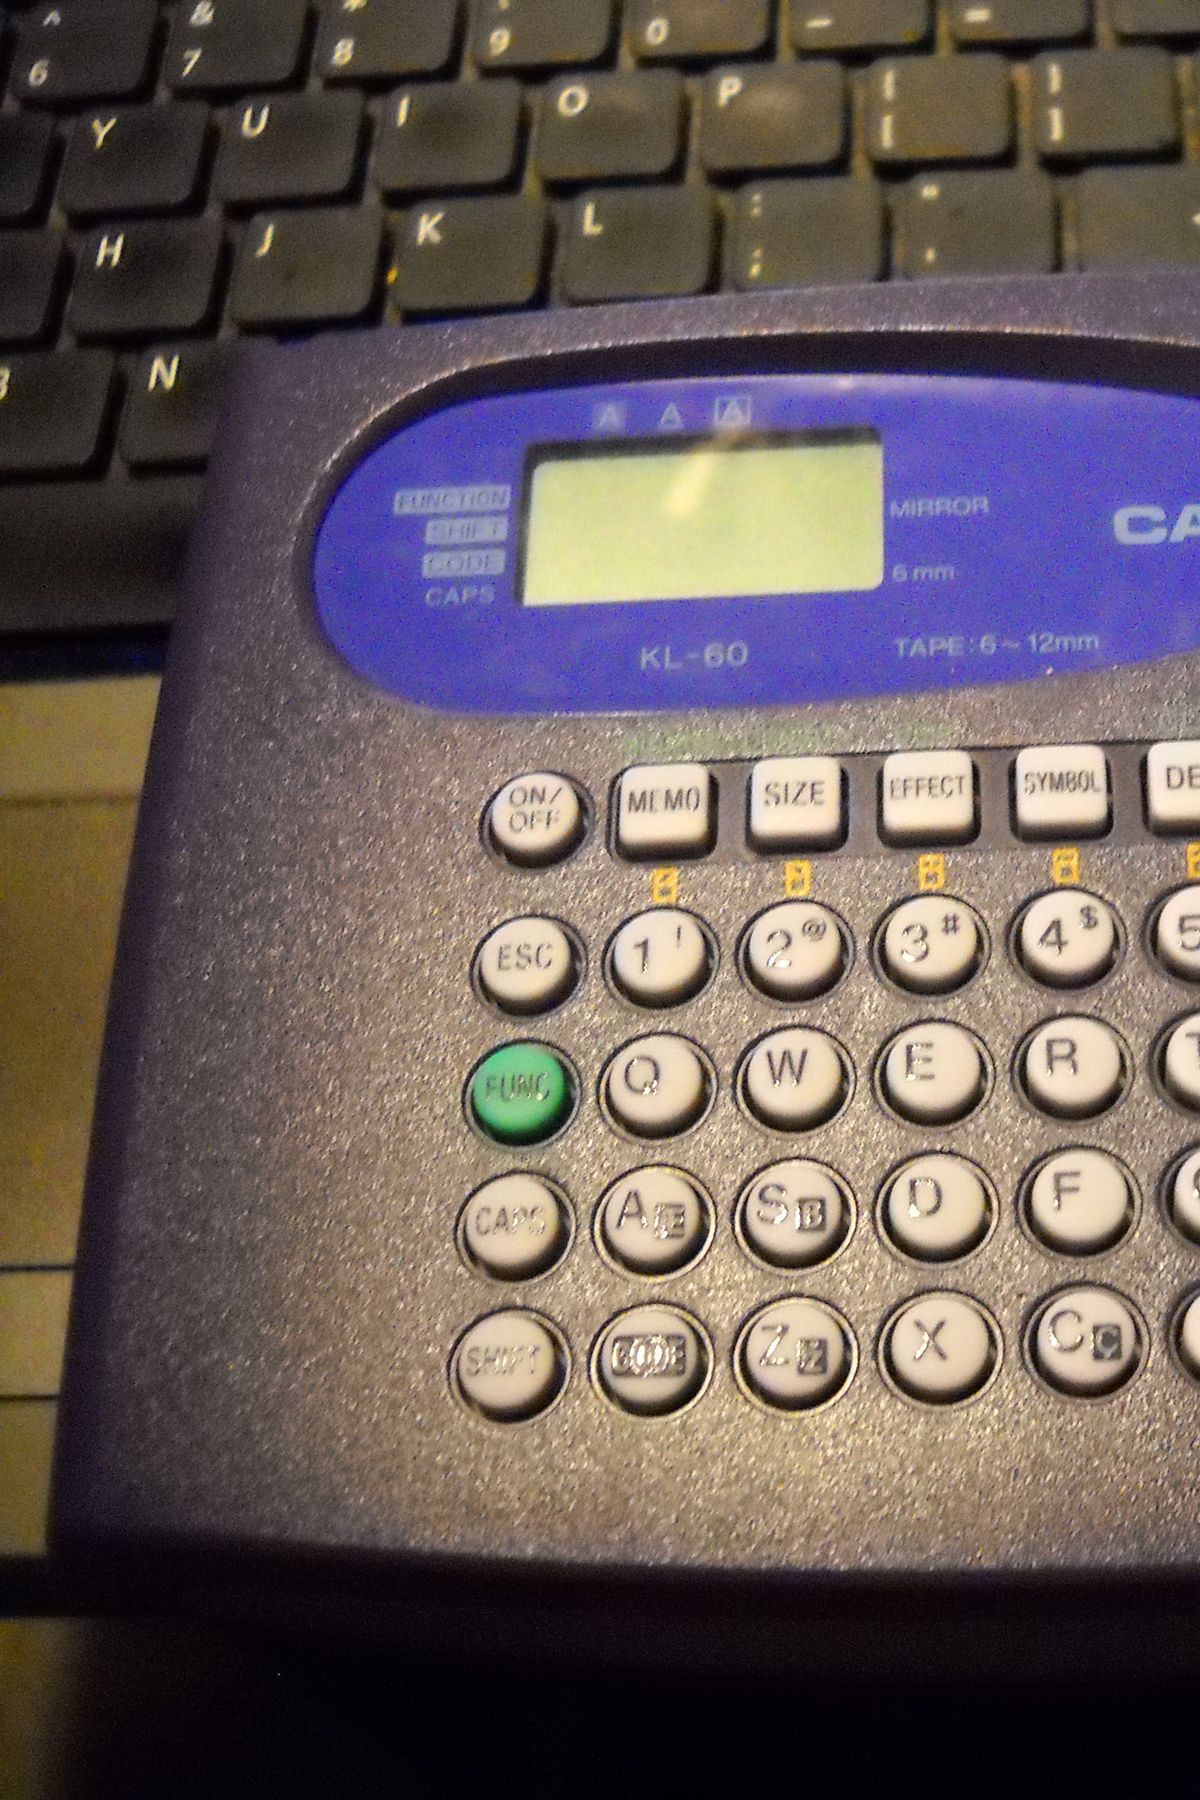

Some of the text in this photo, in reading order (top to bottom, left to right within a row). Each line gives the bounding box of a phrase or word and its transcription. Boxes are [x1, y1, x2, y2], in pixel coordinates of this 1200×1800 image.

[331, 38, 353, 66] 8
[489, 27, 511, 57] 9
[28, 59, 49, 86] 6
[181, 48, 201, 77] 7
[557, 84, 589, 118] O
[717, 76, 743, 107] P
[242, 105, 269, 138] U
[396, 95, 411, 127] I
[92, 116, 117, 149] Y
[416, 212, 444, 246] K
[583, 204, 603, 236] L
[96, 233, 125, 268] H
[256, 224, 275, 257] J
[148, 355, 180, 392] N
[398, 487, 508, 511] FUNCTION
[890, 495, 990, 518] MIRROR
[425, 552, 496, 577] CODE
[892, 563, 955, 582] 6 mm
[425, 585, 496, 607] CAPS
[639, 640, 750, 671] KL-60
[509, 786, 564, 808] ON/
[764, 780, 826, 808] SIZE
[889, 774, 965, 800] EFFECT
[1023, 769, 1101, 797] SYMBOL
[628, 786, 701, 816] MEMO
[509, 809, 560, 833] OFF
[765, 916, 828, 969] 2 @
[901, 912, 961, 963] 3 #
[1038, 902, 1099, 957] 4 $
[496, 942, 554, 971] ESC
[633, 937, 650, 975] 1
[767, 1048, 808, 1088] W
[904, 1041, 936, 1082] E
[1044, 1038, 1079, 1077] R
[485, 1070, 553, 1103] FUNC
[622, 1055, 660, 1096] Q
[757, 1184, 789, 1225] S
[908, 1177, 942, 1218] D
[1053, 1170, 1082, 1212] F
[475, 1206, 546, 1237] CAPS
[616, 1188, 648, 1229] A
[759, 1323, 790, 1367] Z
[913, 1318, 948, 1361] X
[1047, 1307, 1085, 1354] C
[467, 1344, 542, 1378] SHIFT
